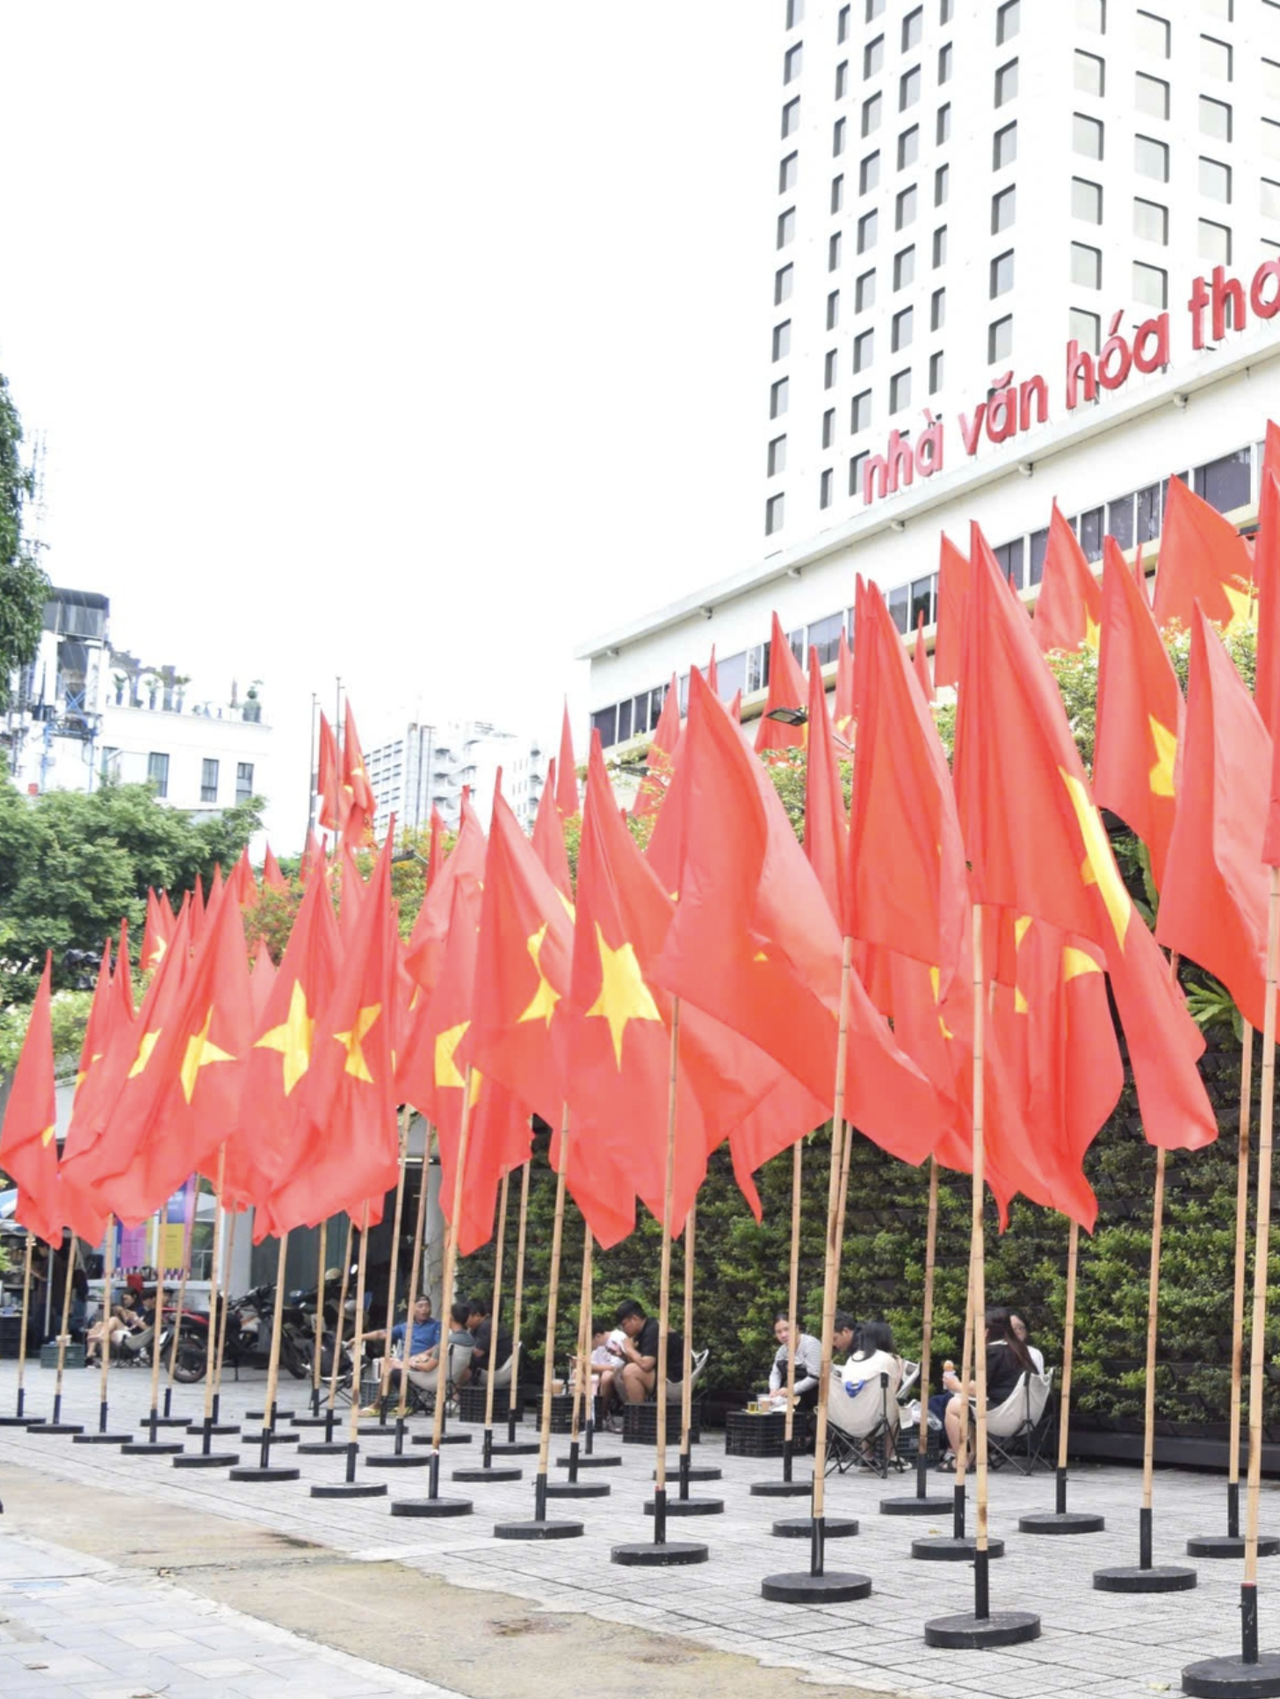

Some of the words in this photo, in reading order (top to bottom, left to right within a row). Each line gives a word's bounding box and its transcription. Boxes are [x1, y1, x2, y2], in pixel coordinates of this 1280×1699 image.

[863, 406, 945, 504] nhà
[959, 370, 1050, 456] văn
[1066, 308, 1170, 410] hóa
